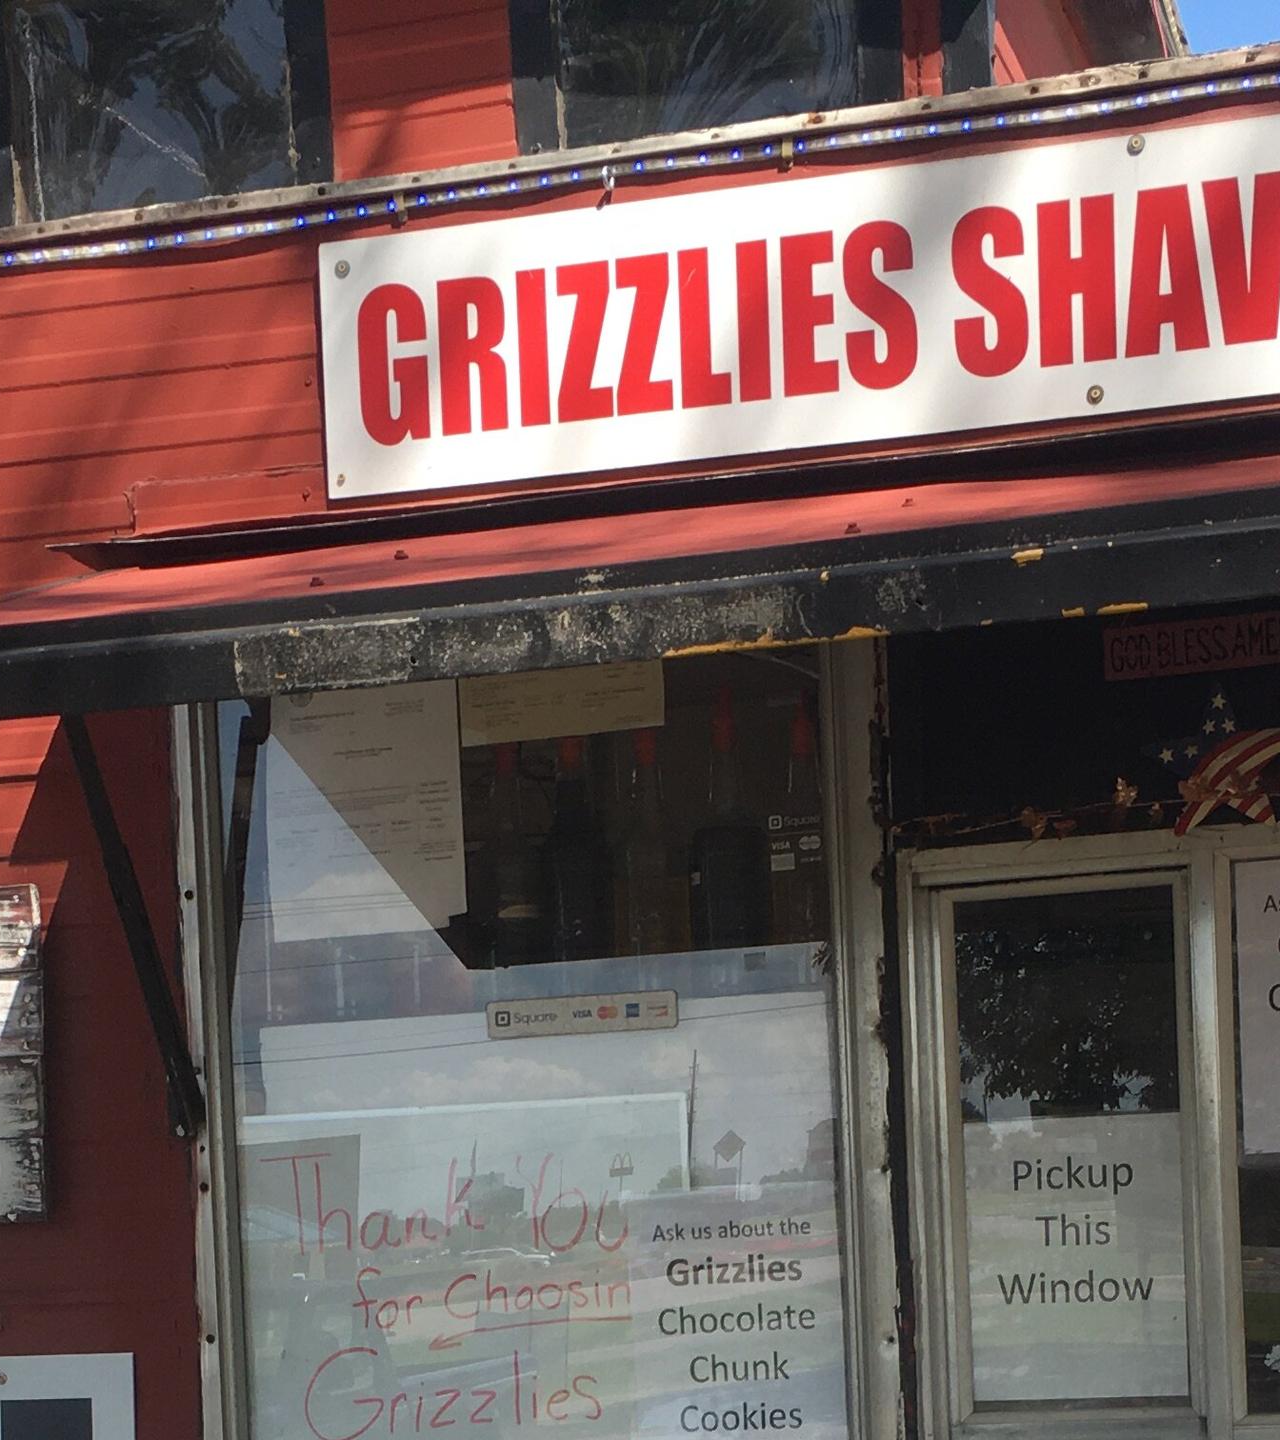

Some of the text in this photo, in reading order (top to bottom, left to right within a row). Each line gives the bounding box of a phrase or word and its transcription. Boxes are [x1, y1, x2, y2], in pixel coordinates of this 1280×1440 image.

[357, 220, 918, 447] GRIZZLIES
[1110, 634, 1152, 672] GOD
[1157, 625, 1228, 668] BLESS
[513, 1011, 558, 1026] Square
[571, 1010, 593, 1019] VISA
[1012, 1155, 1134, 1196] Pickup
[258, 1152, 485, 1256] Thank
[652, 1217, 811, 1242] Ask us about the
[1034, 1213, 1111, 1247] This
[666, 1253, 803, 1287] Grizzlies
[997, 1269, 1154, 1305] Window
[353, 1265, 423, 1329] for
[658, 1303, 816, 1335] Chocolate
[689, 1351, 790, 1383] Chunk
[680, 1402, 803, 1433] Cookies
